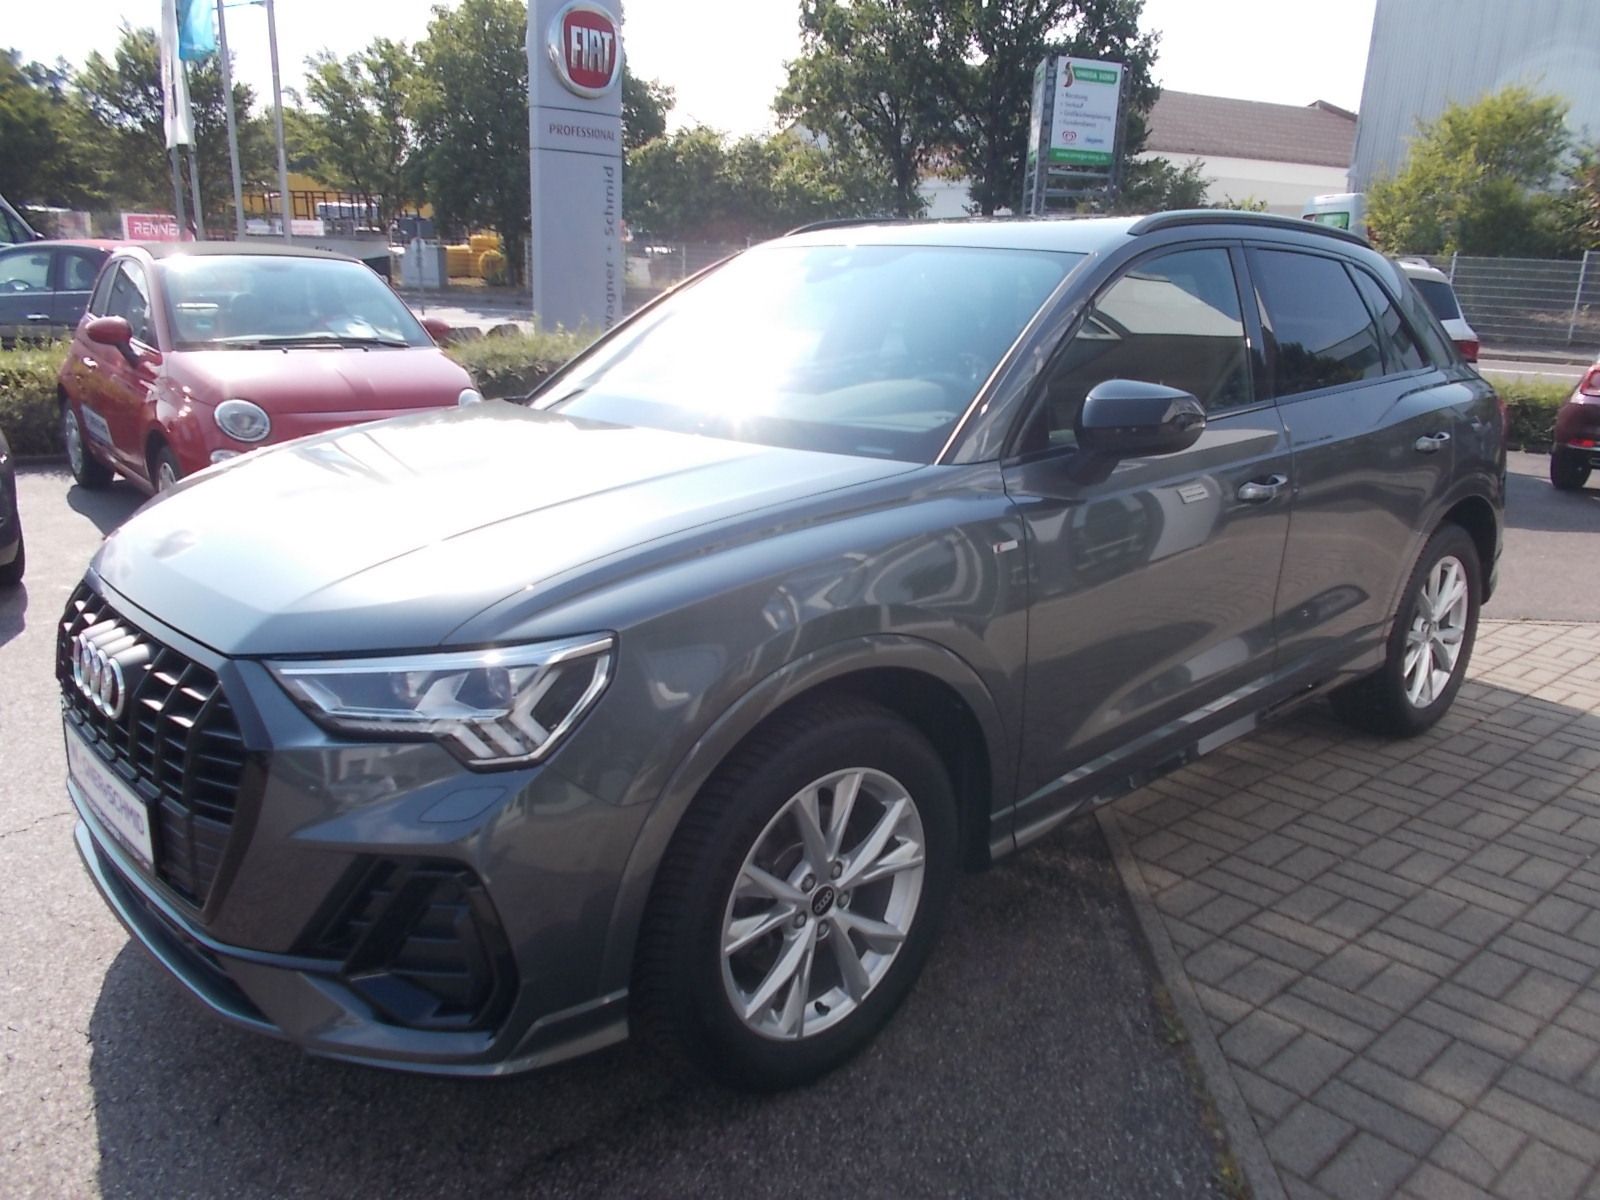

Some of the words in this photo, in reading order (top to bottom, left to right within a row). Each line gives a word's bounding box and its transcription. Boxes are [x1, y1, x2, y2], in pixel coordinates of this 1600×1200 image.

[571, 25, 613, 74] FIAT
[548, 122, 615, 141] PROFESSIONAL
[603, 166, 615, 236] Schmid
[605, 261, 616, 331] Wagner
